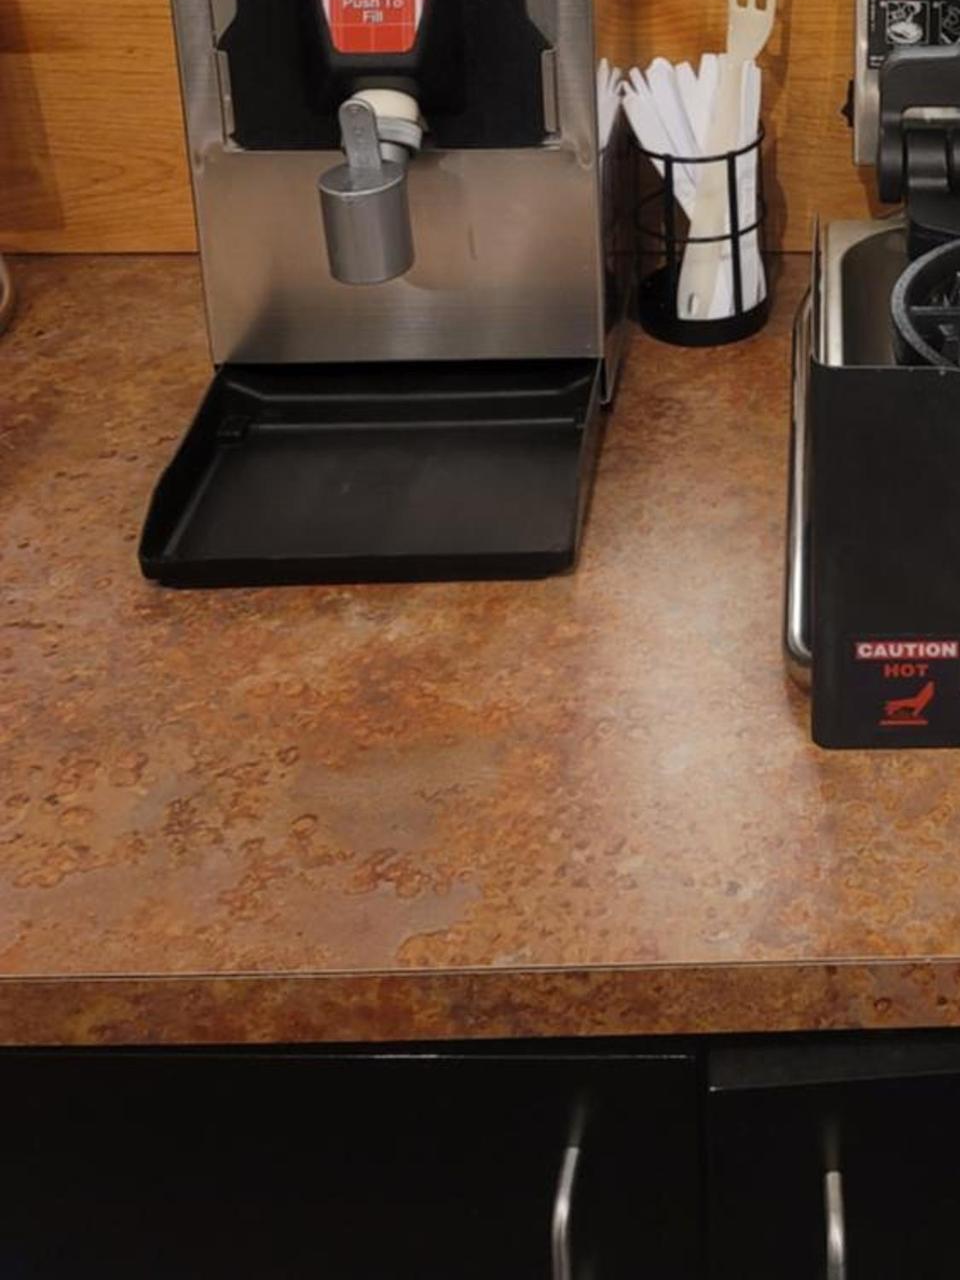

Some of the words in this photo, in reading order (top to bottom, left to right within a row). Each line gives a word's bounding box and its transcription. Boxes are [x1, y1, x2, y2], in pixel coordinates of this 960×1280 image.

[362, 10, 384, 24] Fill
[856, 642, 958, 658] CAUTION
[884, 663, 929, 678] HOT
